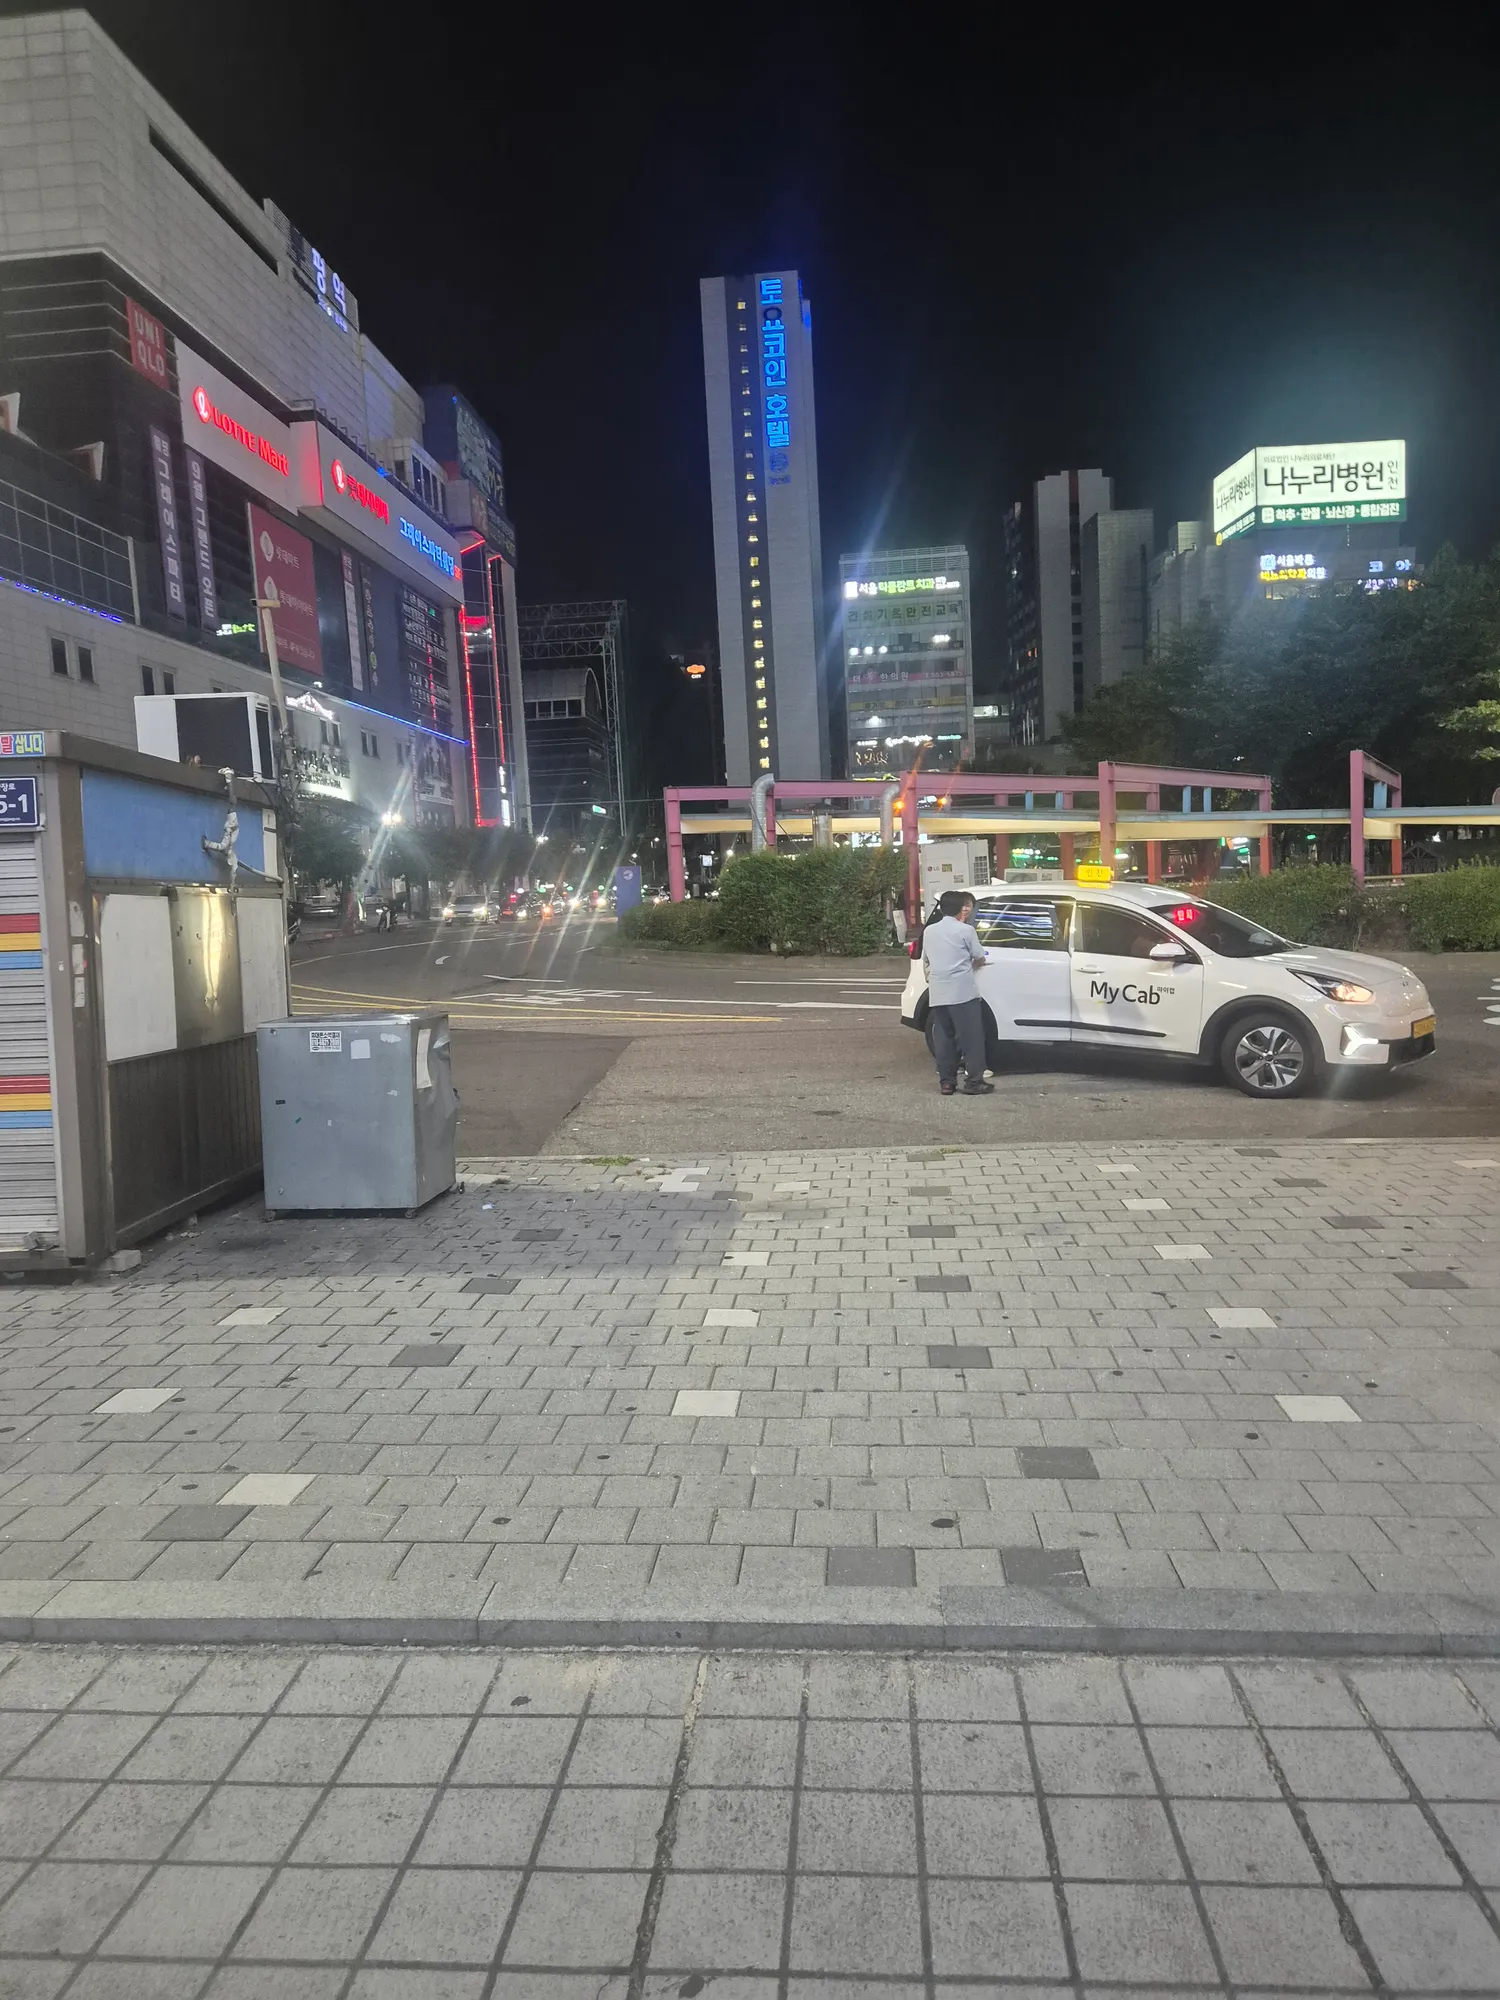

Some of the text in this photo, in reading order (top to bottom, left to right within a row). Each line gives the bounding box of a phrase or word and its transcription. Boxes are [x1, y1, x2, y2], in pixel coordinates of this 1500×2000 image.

[134, 309, 160, 349] UNI
[760, 278, 787, 388] 토요코인
[137, 340, 165, 377] QLO
[766, 393, 790, 448] 호텔
[213, 407, 289, 477] LOTTE Mart
[1264, 461, 1384, 495] 나누리병원
[1387, 460, 1399, 490] 인천
[15, 734, 42, 754] 삽니다
[0, 783, 16, 792] 장로
